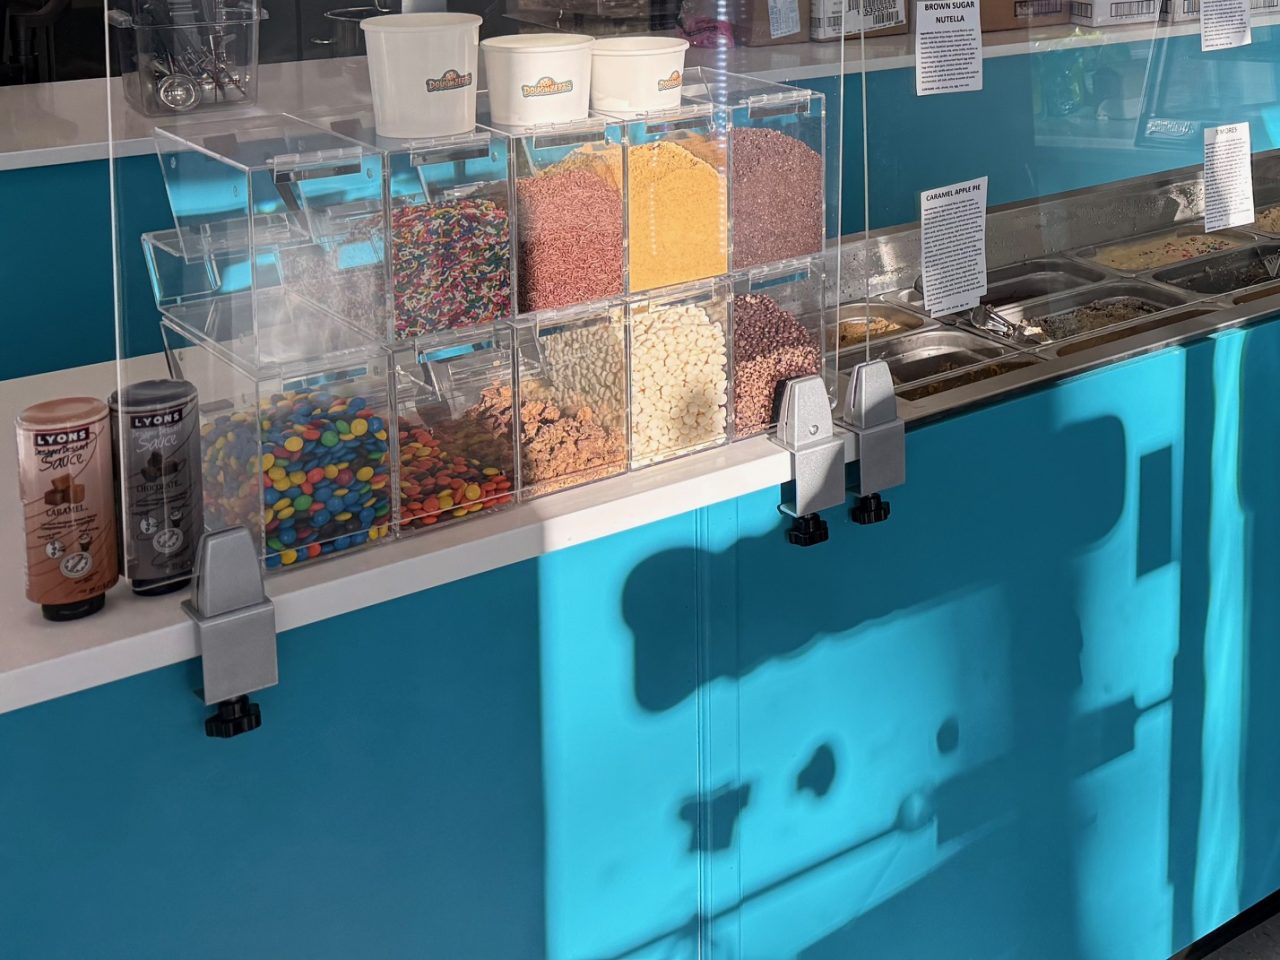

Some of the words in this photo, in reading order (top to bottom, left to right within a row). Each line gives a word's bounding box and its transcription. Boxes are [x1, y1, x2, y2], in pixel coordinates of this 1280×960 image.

[924, 2, 951, 11] BROWN
[952, 1, 975, 9] SUGAR
[935, 15, 965, 24] NUTELLA
[926, 190, 953, 202] CARAMEL
[954, 186, 971, 197] APPLE
[972, 183, 982, 192] PIE
[135, 413, 180, 426] LYONS
[37, 431, 87, 445] LYONS
[136, 434, 177, 452] Sauce
[39, 453, 86, 471] Sauce
[46, 504, 85, 518] CARAMEL
